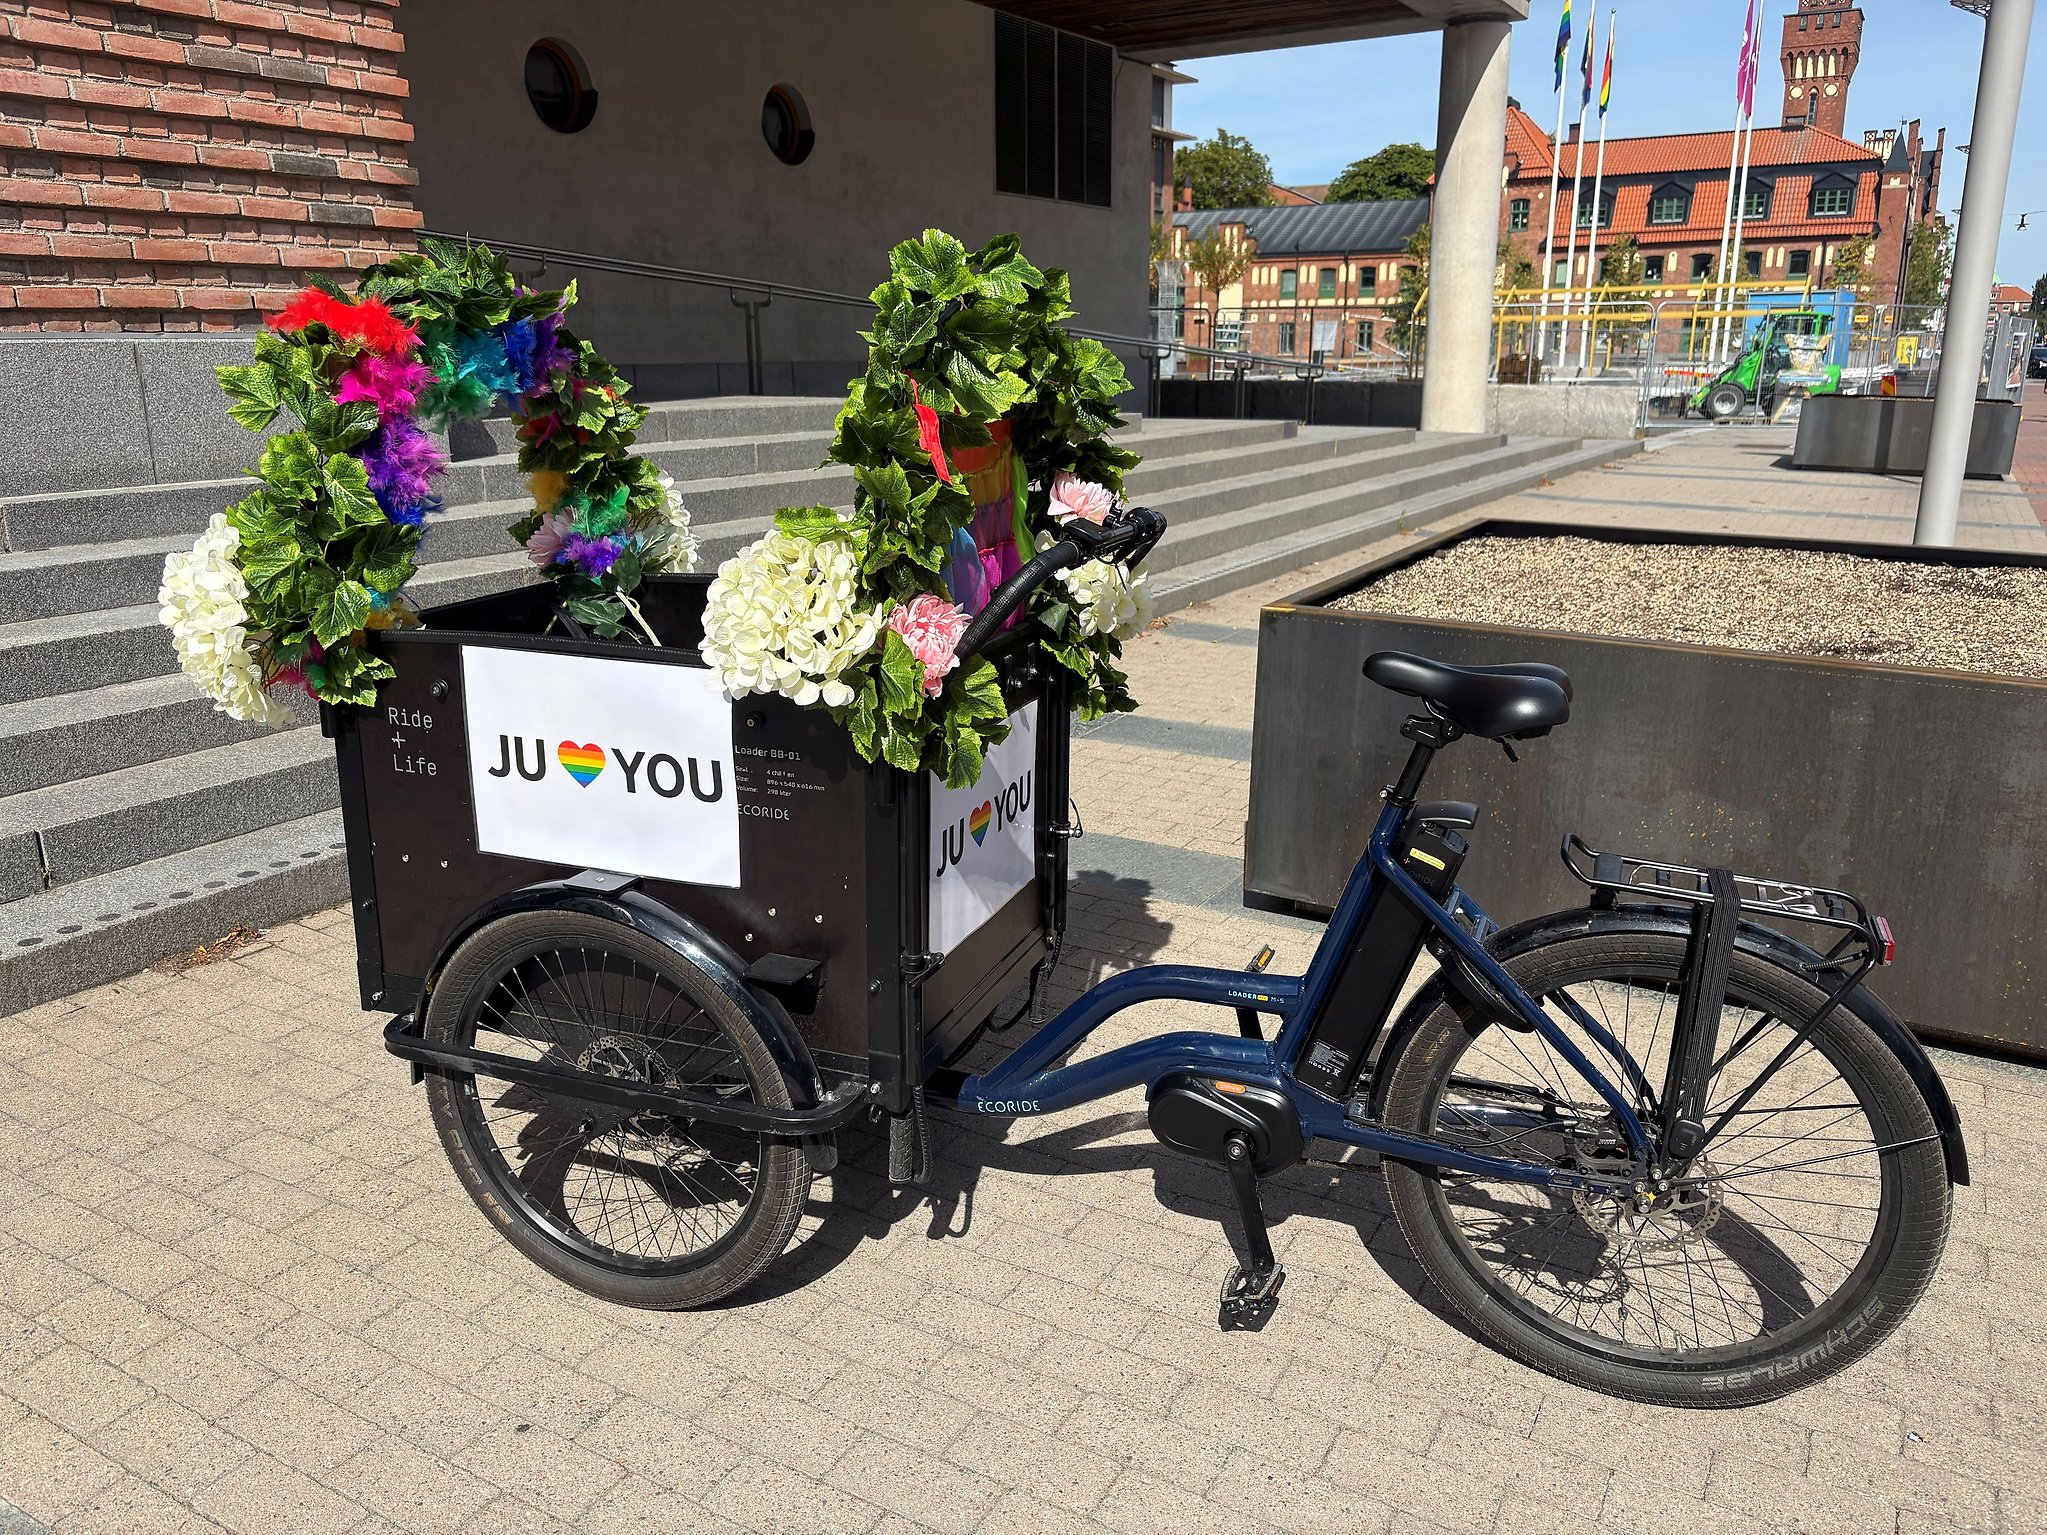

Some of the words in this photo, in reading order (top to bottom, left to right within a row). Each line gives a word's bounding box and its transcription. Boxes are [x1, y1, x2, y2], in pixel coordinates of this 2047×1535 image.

[388, 706, 433, 729] Ride
[734, 745, 769, 757] Loader
[770, 749, 801, 761] BB-01
[393, 753, 437, 776] Life
[488, 734, 546, 782] JU
[611, 747, 723, 803] YOU
[738, 803, 790, 821] ECORIDE
[935, 817, 965, 878] JU
[993, 769, 1031, 832] YOU
[1228, 990, 1257, 1000] LOADER
[977, 1100, 1041, 1113] ECORIDE
